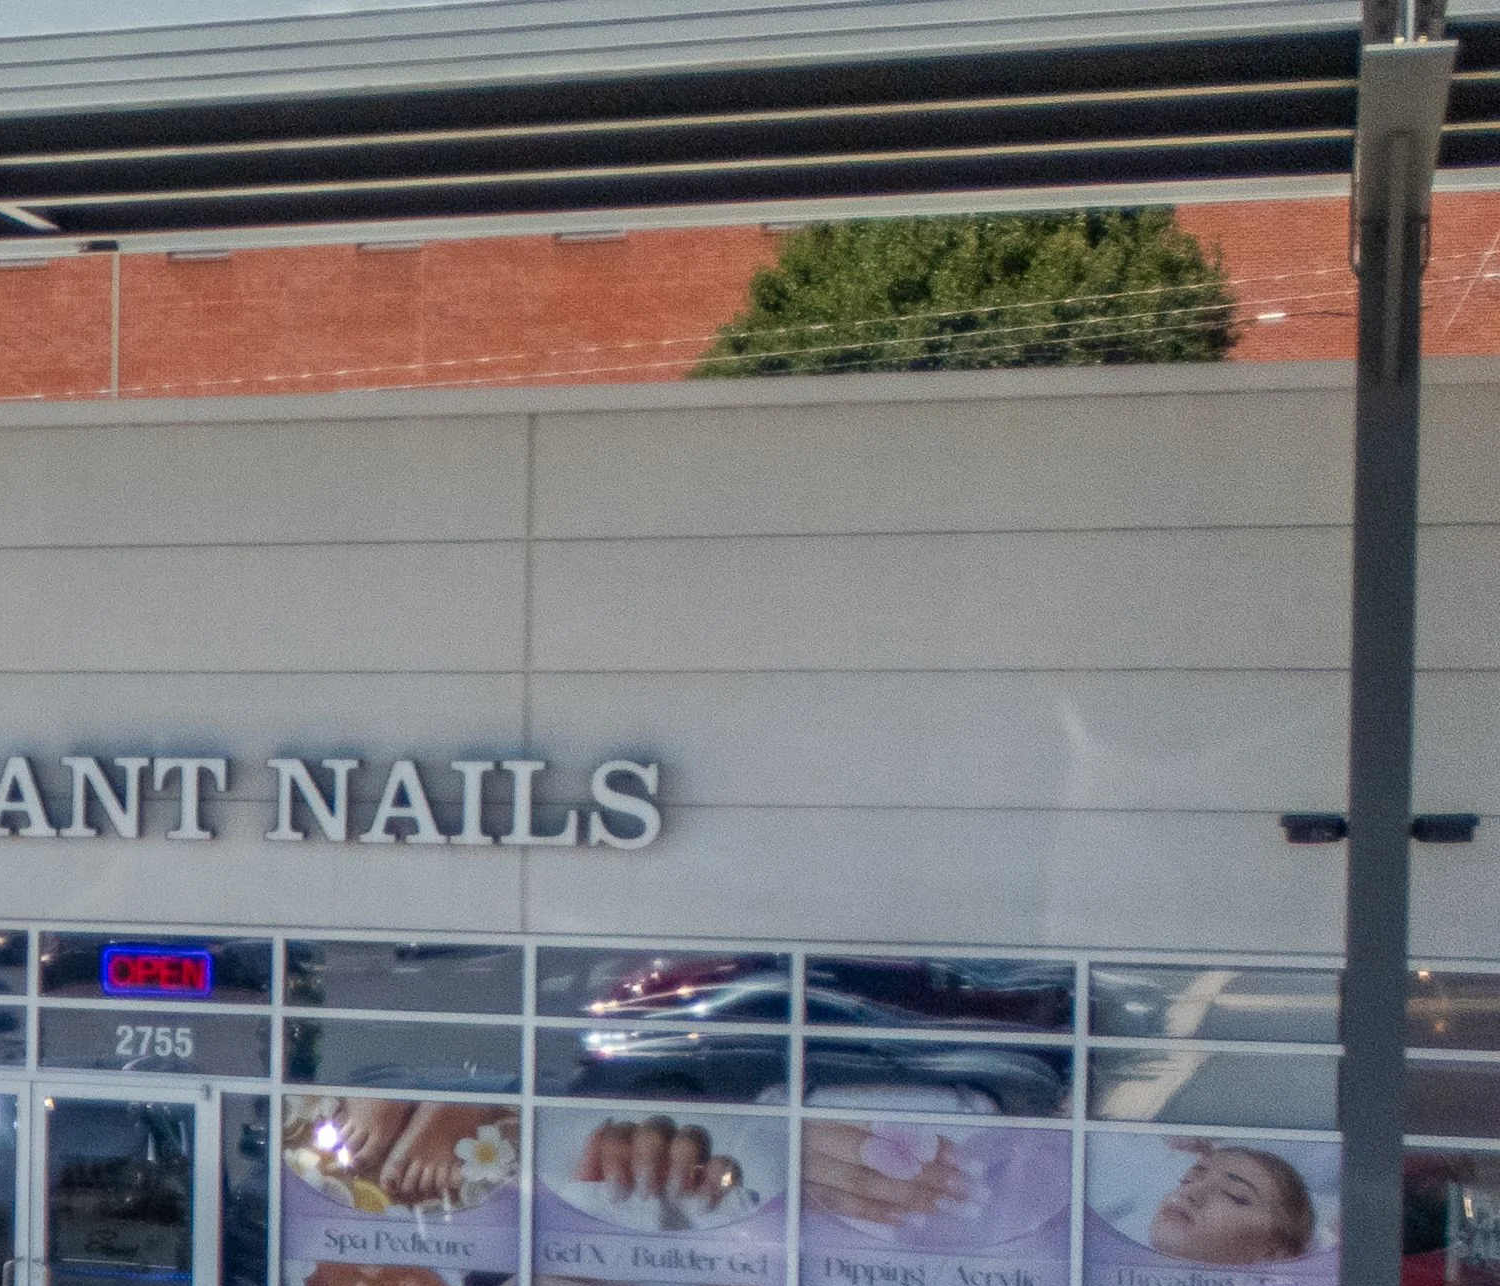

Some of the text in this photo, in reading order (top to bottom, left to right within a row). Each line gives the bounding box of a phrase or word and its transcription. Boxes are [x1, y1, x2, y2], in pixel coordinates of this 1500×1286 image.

[265, 757, 661, 850] NAILS
[108, 954, 206, 990] OPEN
[115, 1025, 194, 1058] 2755
[323, 1229, 476, 1258] Spa Pedicure
[543, 1241, 582, 1266] Gel
[631, 1245, 721, 1273] Builder
[729, 1249, 769, 1276] Gel
